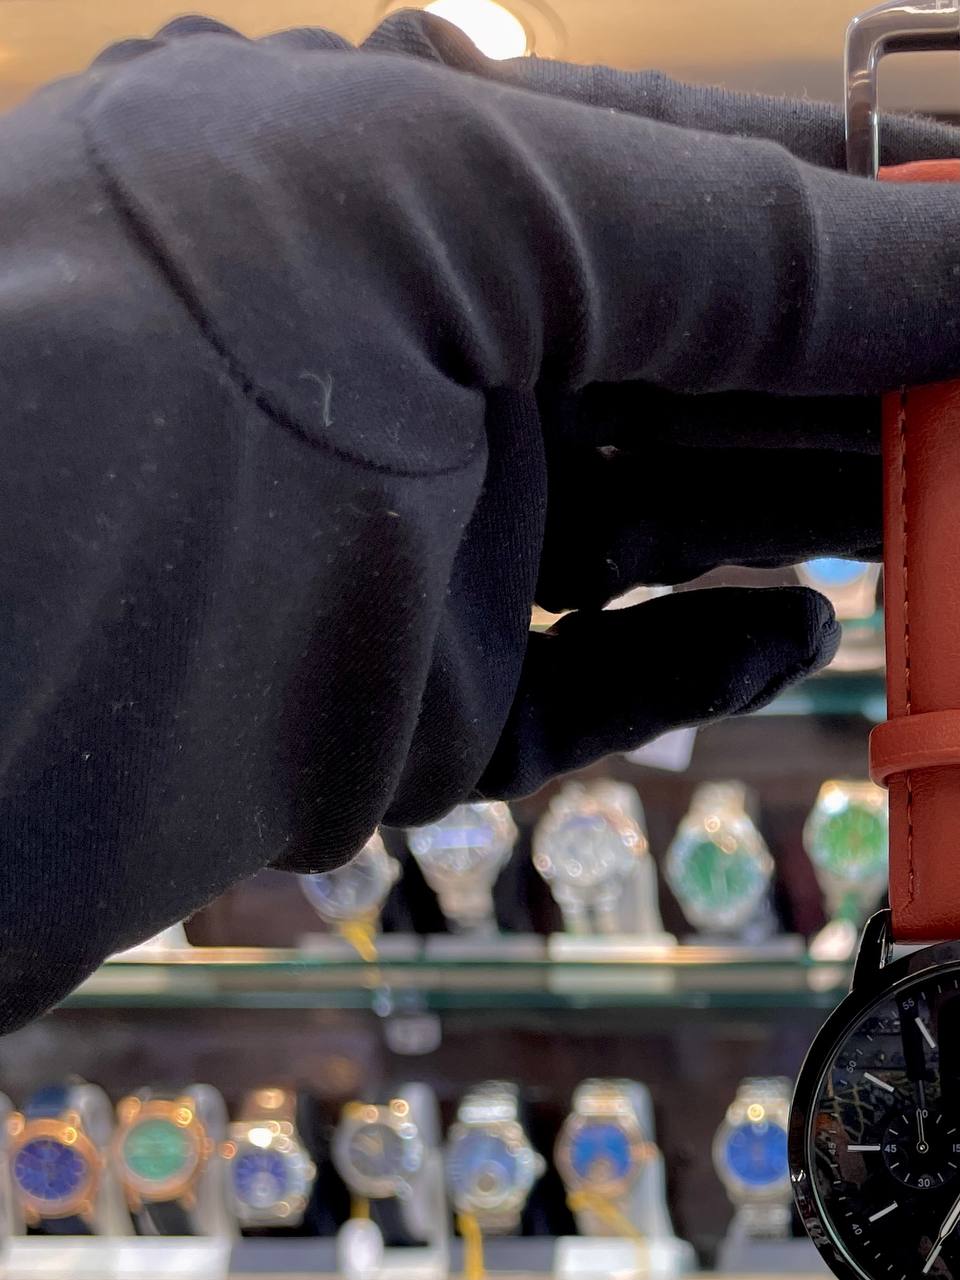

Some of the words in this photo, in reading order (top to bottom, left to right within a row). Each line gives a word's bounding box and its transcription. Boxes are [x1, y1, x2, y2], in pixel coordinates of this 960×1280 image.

[902, 998, 915, 1011] 55
[846, 1060, 857, 1073] 50
[884, 1144, 897, 1152] 45
[917, 1178, 930, 1187] 30
[851, 1223, 863, 1236] 40
